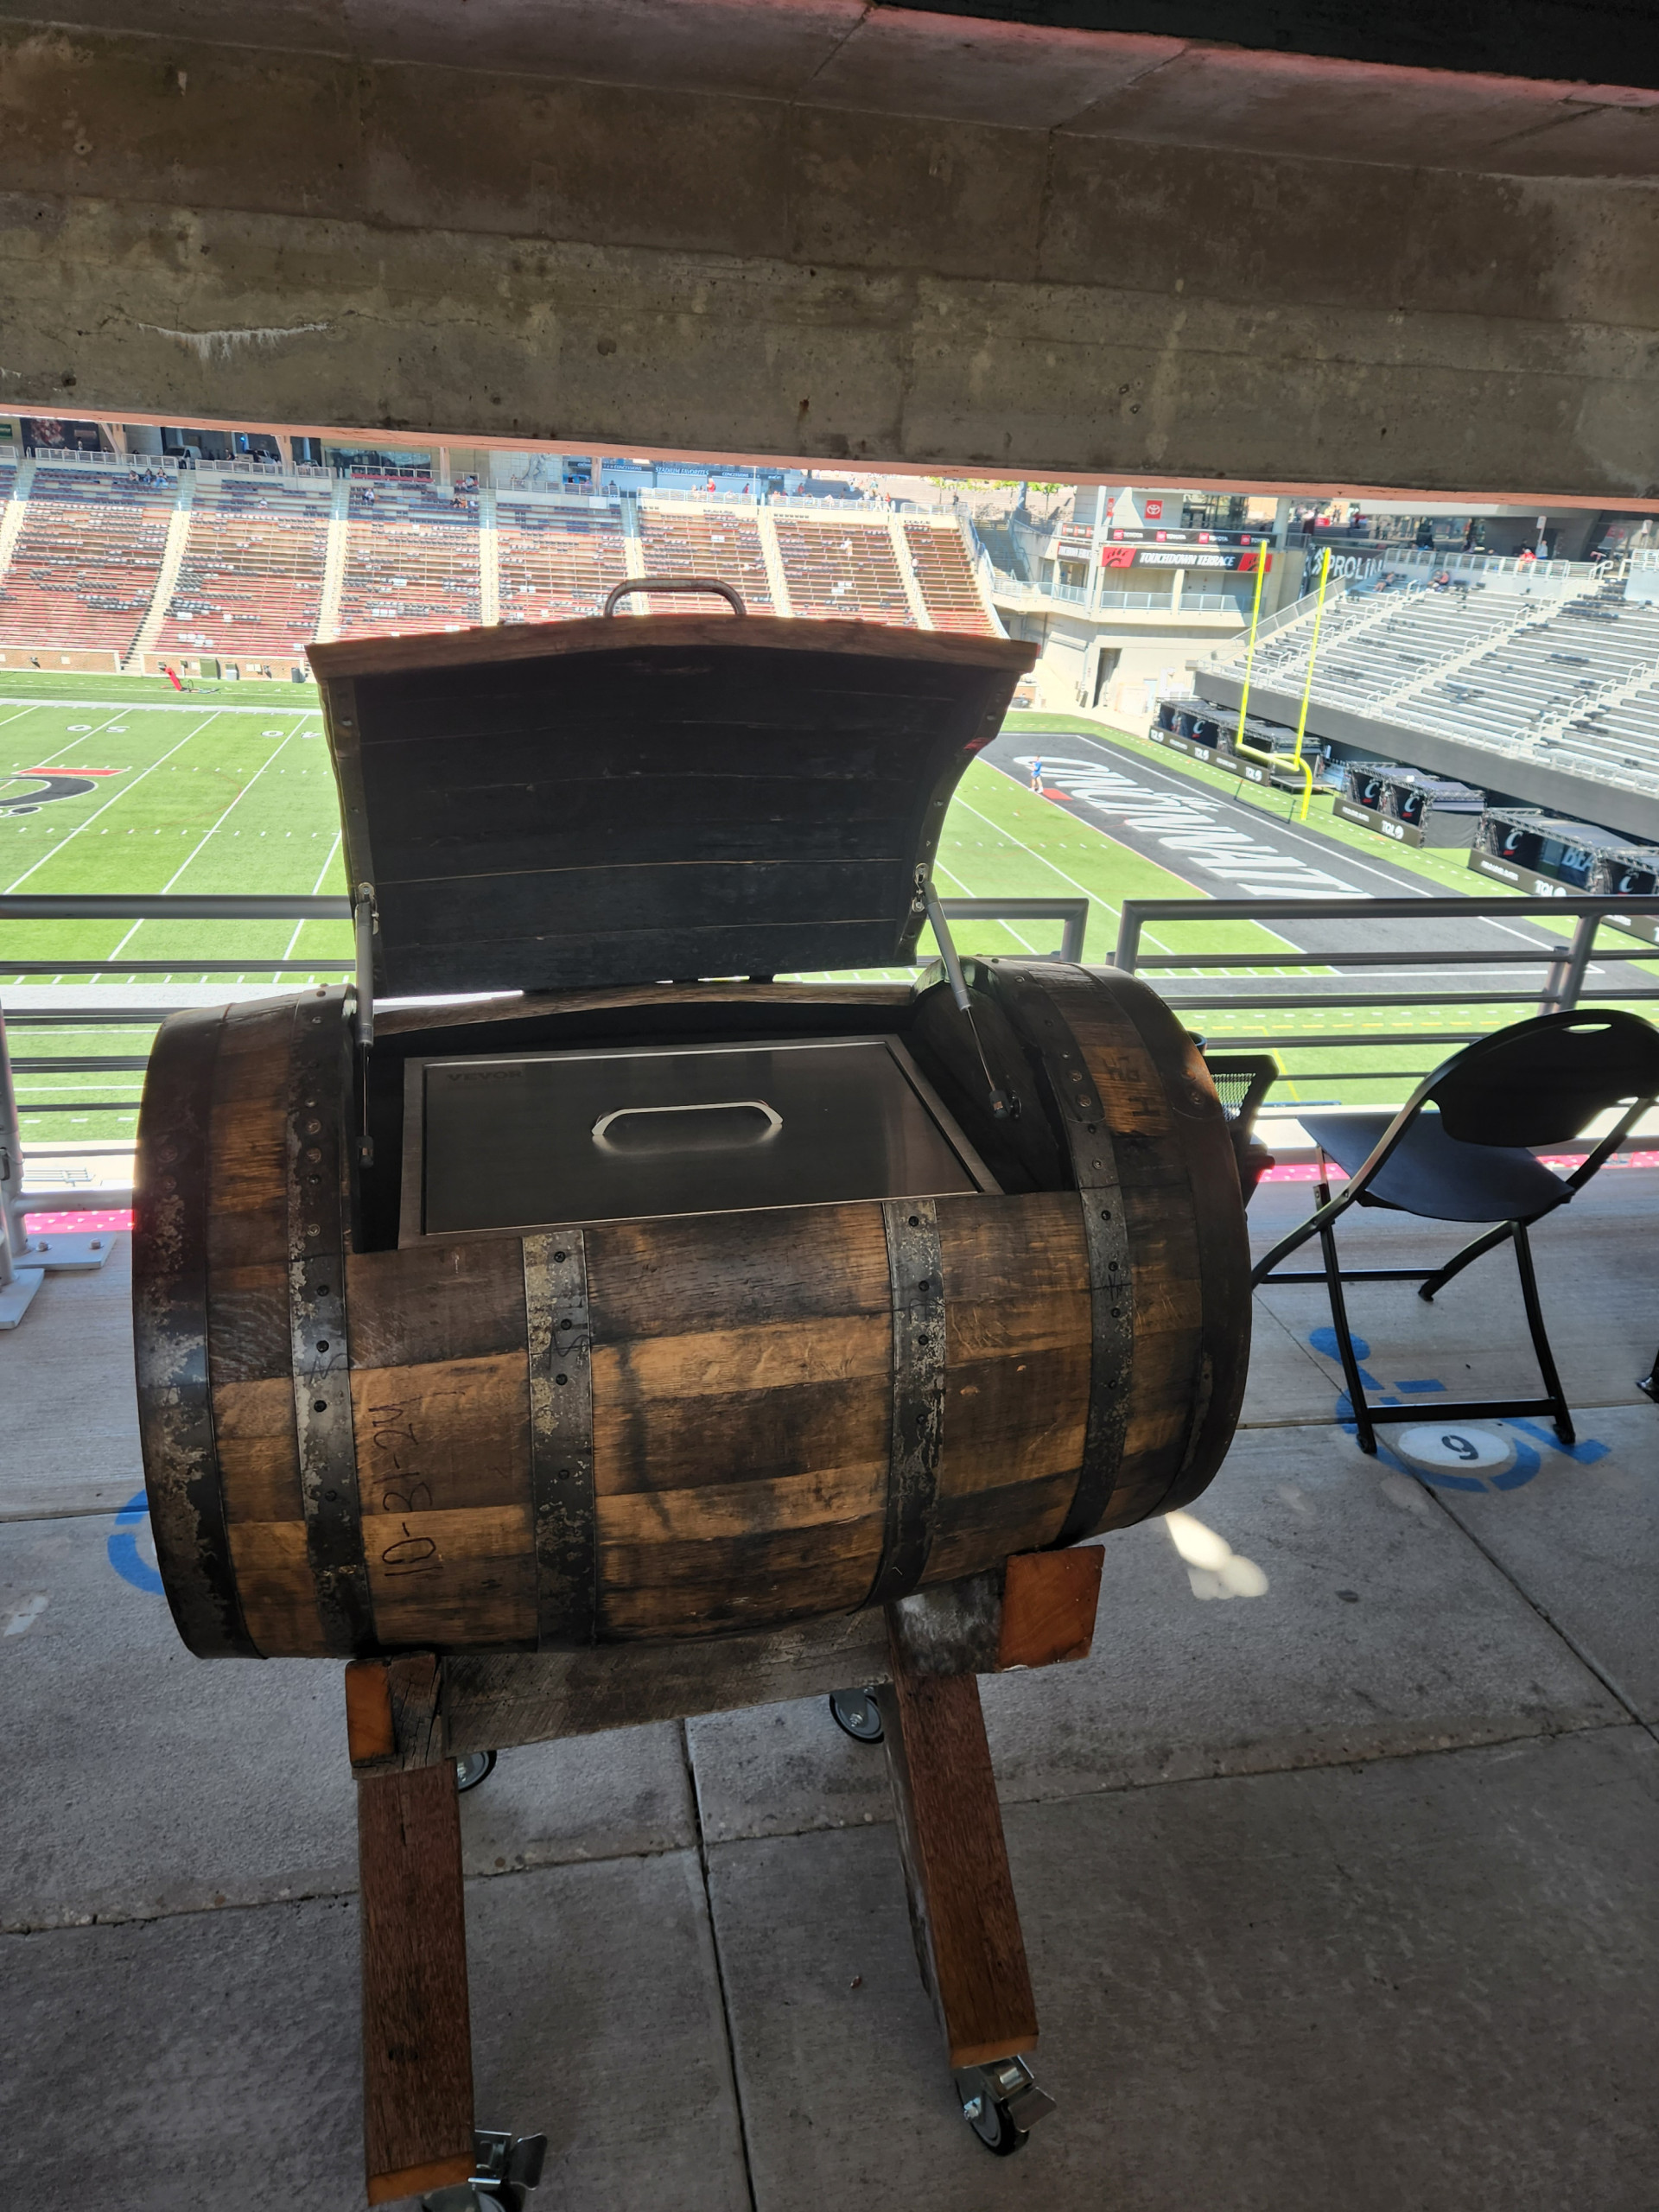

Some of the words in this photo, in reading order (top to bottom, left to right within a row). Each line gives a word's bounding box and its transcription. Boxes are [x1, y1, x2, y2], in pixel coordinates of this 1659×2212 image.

[1140, 552, 1198, 565] TOUCHDOWN
[1196, 555, 1236, 566] TERRACE
[1441, 1434, 1479, 1460] 9
